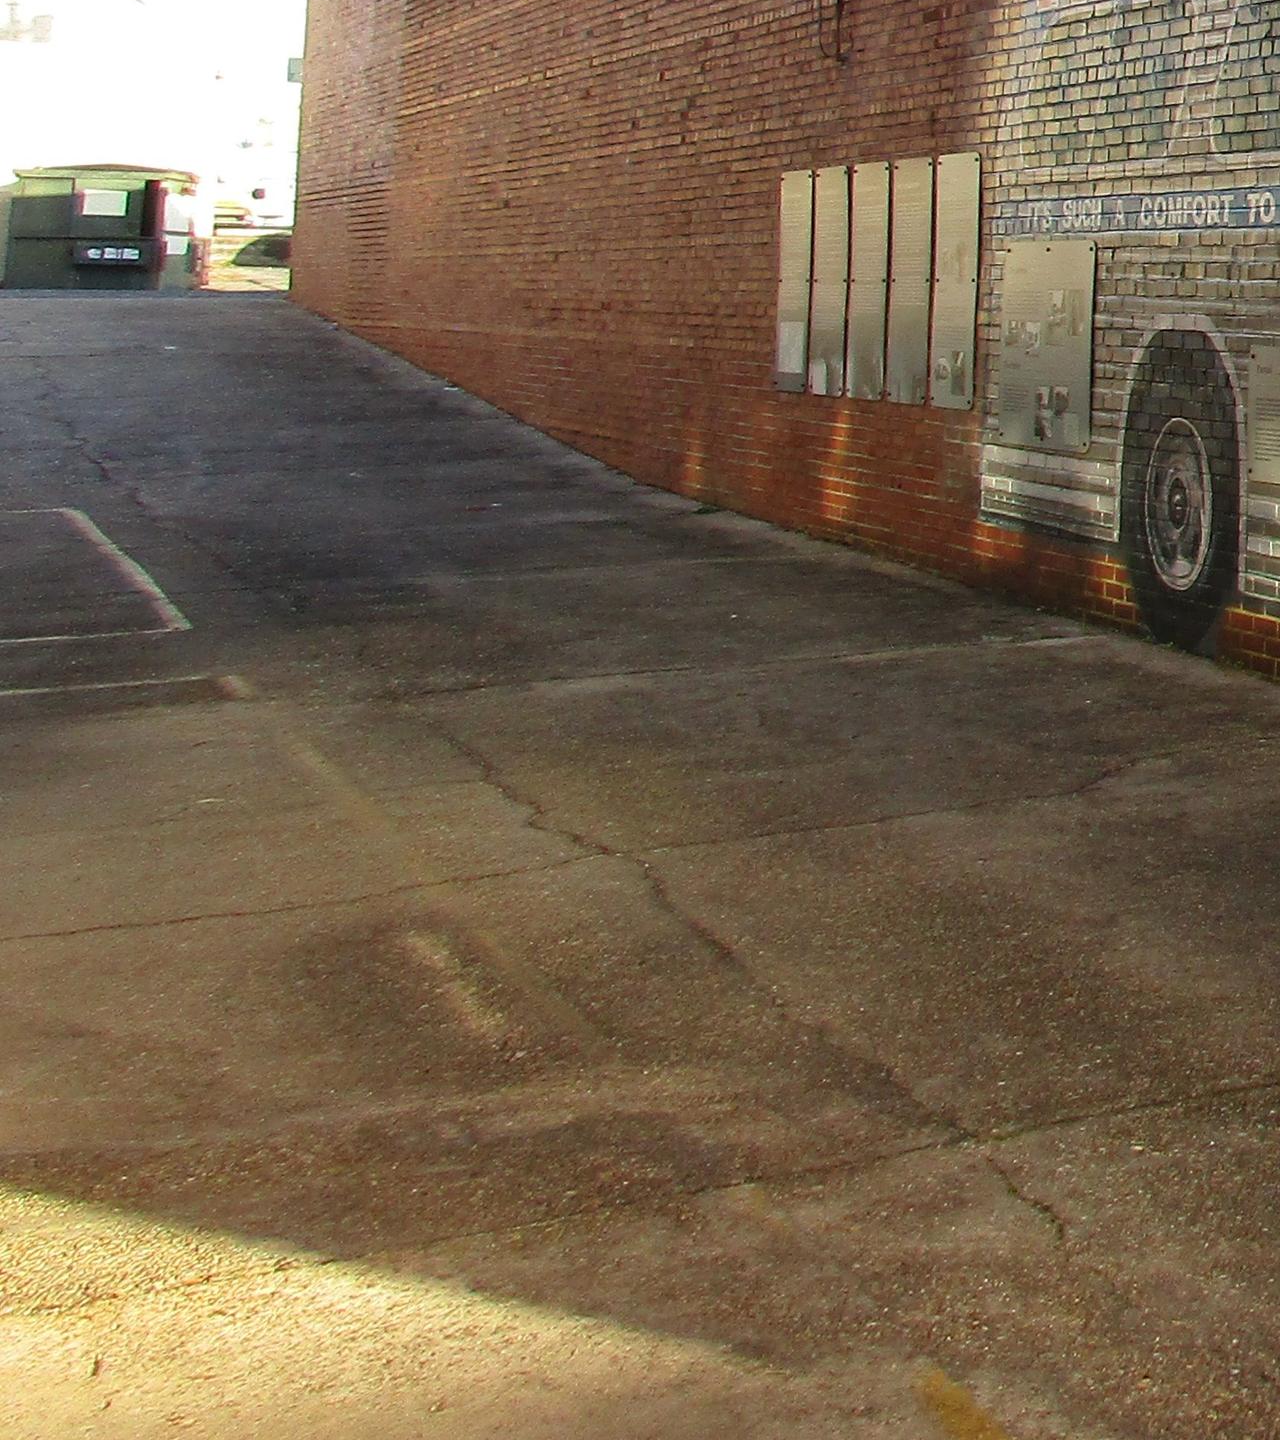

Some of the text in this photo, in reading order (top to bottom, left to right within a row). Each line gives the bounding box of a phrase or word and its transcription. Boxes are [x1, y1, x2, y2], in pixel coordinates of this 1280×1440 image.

[1062, 198, 1101, 229] SUCH
[1113, 199, 1126, 226] A
[1140, 194, 1234, 227] COMFORT
[1246, 191, 1276, 224] TO
